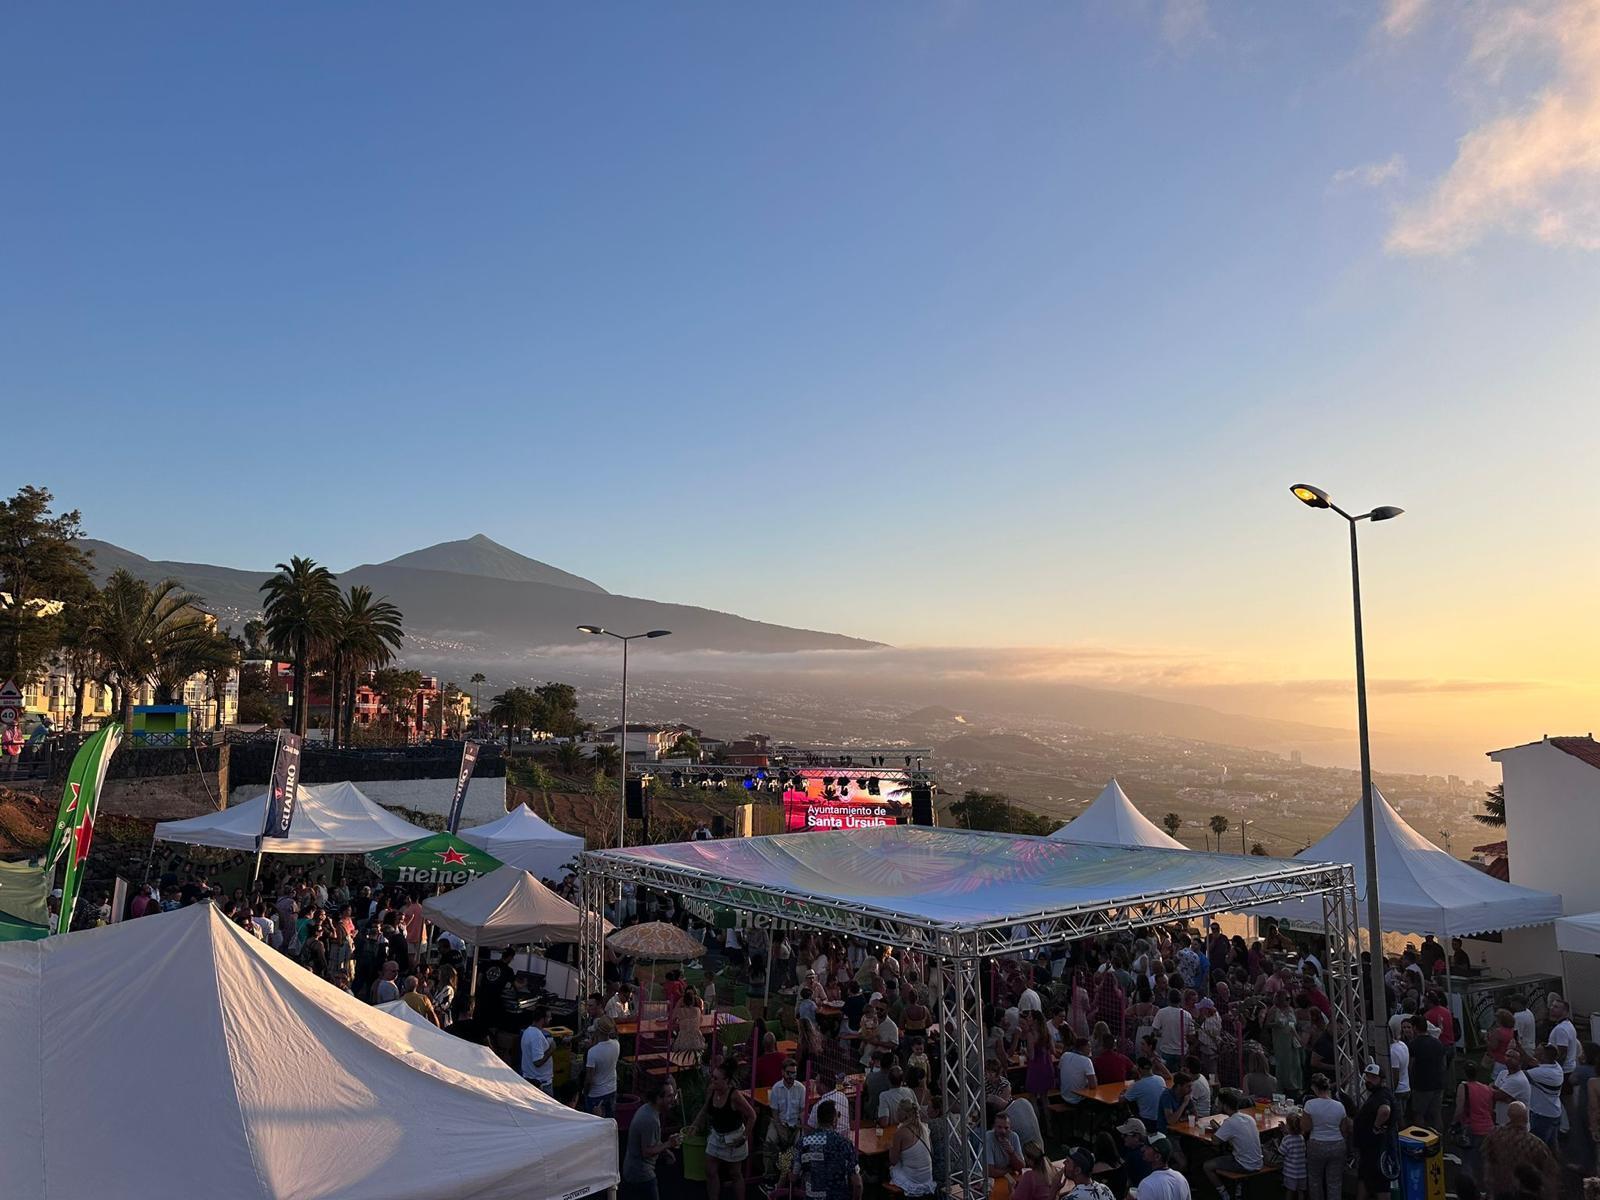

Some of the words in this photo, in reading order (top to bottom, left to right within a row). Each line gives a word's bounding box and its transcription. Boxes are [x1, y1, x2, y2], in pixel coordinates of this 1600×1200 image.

[281, 764, 296, 831] GUAJIRO
[807, 805, 871, 816] Ayuntamiento
[874, 806, 886, 816] de
[807, 815, 842, 827] Santa
[846, 814, 886, 828] Úrsula
